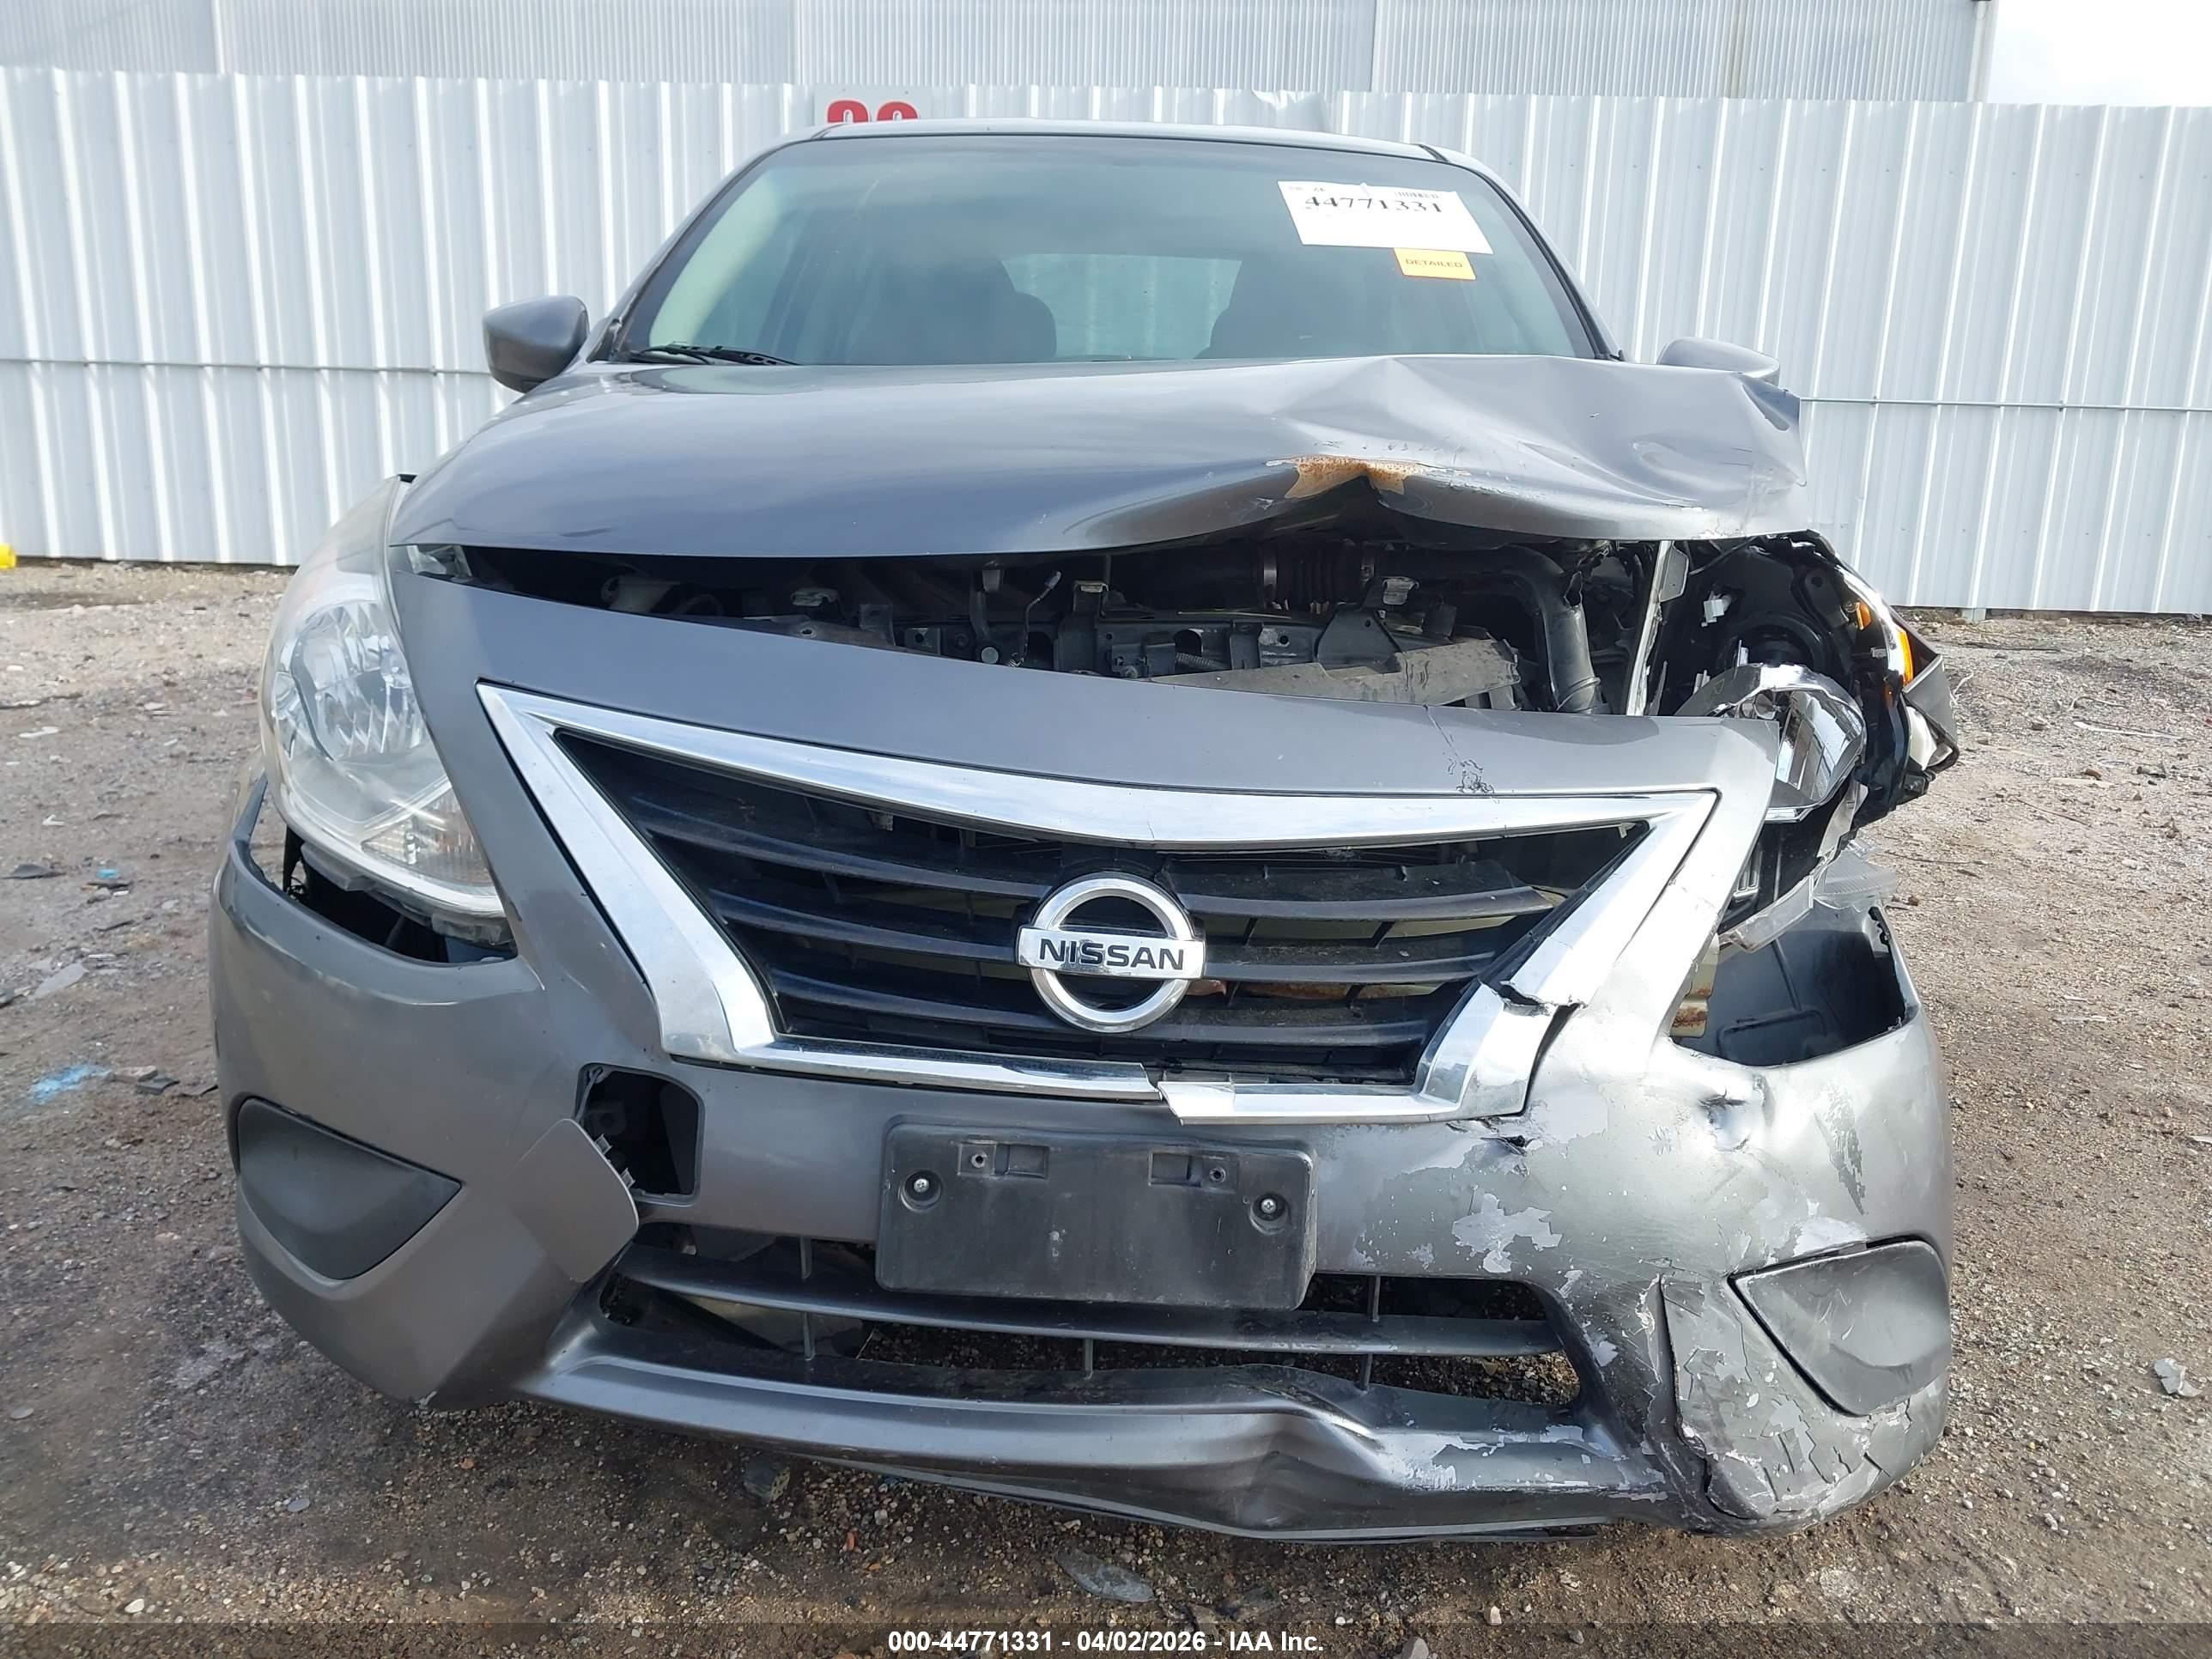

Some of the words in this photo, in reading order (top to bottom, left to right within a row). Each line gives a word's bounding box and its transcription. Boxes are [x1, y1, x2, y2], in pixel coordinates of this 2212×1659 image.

[1304, 196, 1443, 213] 44771331
[1405, 258, 1463, 268] DETAILED
[1039, 938, 1184, 970] NISSAN
